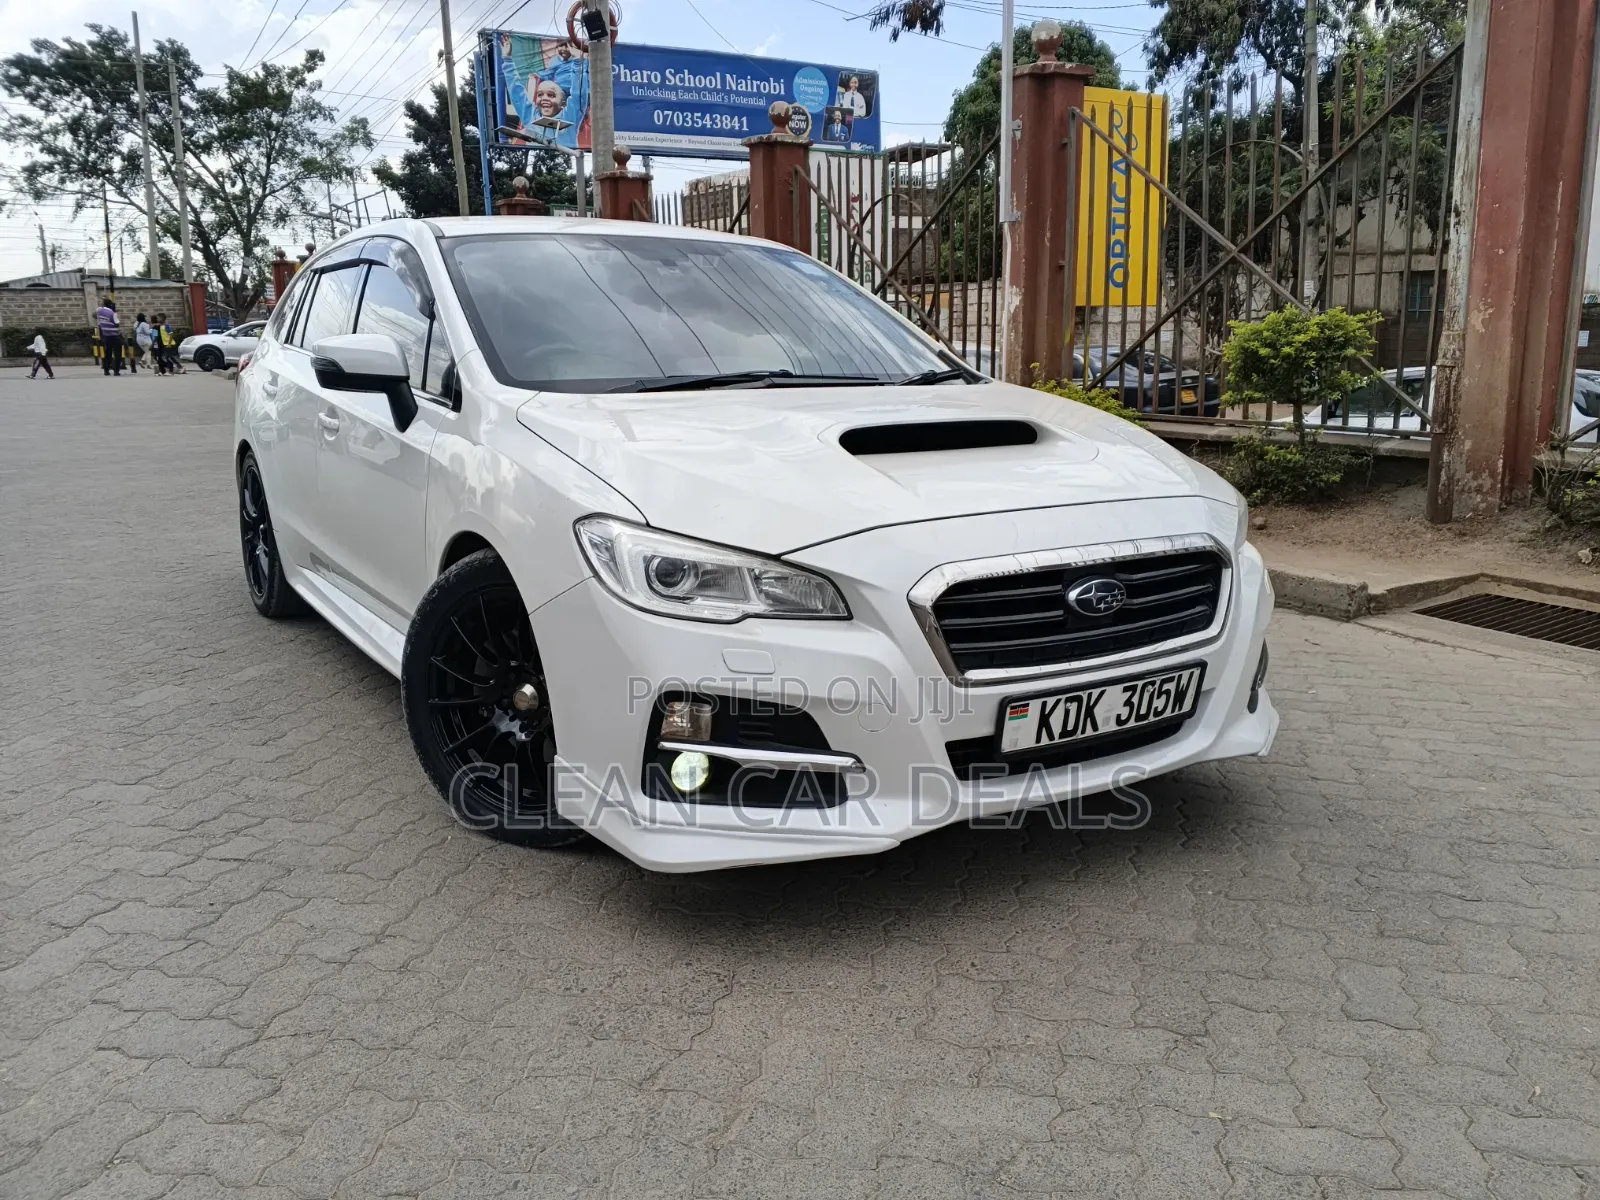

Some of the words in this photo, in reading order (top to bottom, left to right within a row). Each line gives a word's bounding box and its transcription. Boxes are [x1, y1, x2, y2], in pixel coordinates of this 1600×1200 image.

[612, 64, 661, 84] Pharo
[665, 68, 722, 89] School
[725, 73, 785, 95] Nairobi
[794, 76, 827, 85] Admissions
[800, 84, 824, 94] Ongoing
[632, 86, 677, 101] Unlocking
[678, 90, 699, 100] Each
[700, 91, 729, 103] Child's
[730, 94, 766, 106] Potential
[653, 109, 749, 131] 0703543841
[789, 120, 807, 129] NOW
[1035, 689, 1107, 744] KDK
[1116, 671, 1194, 727] 305W
